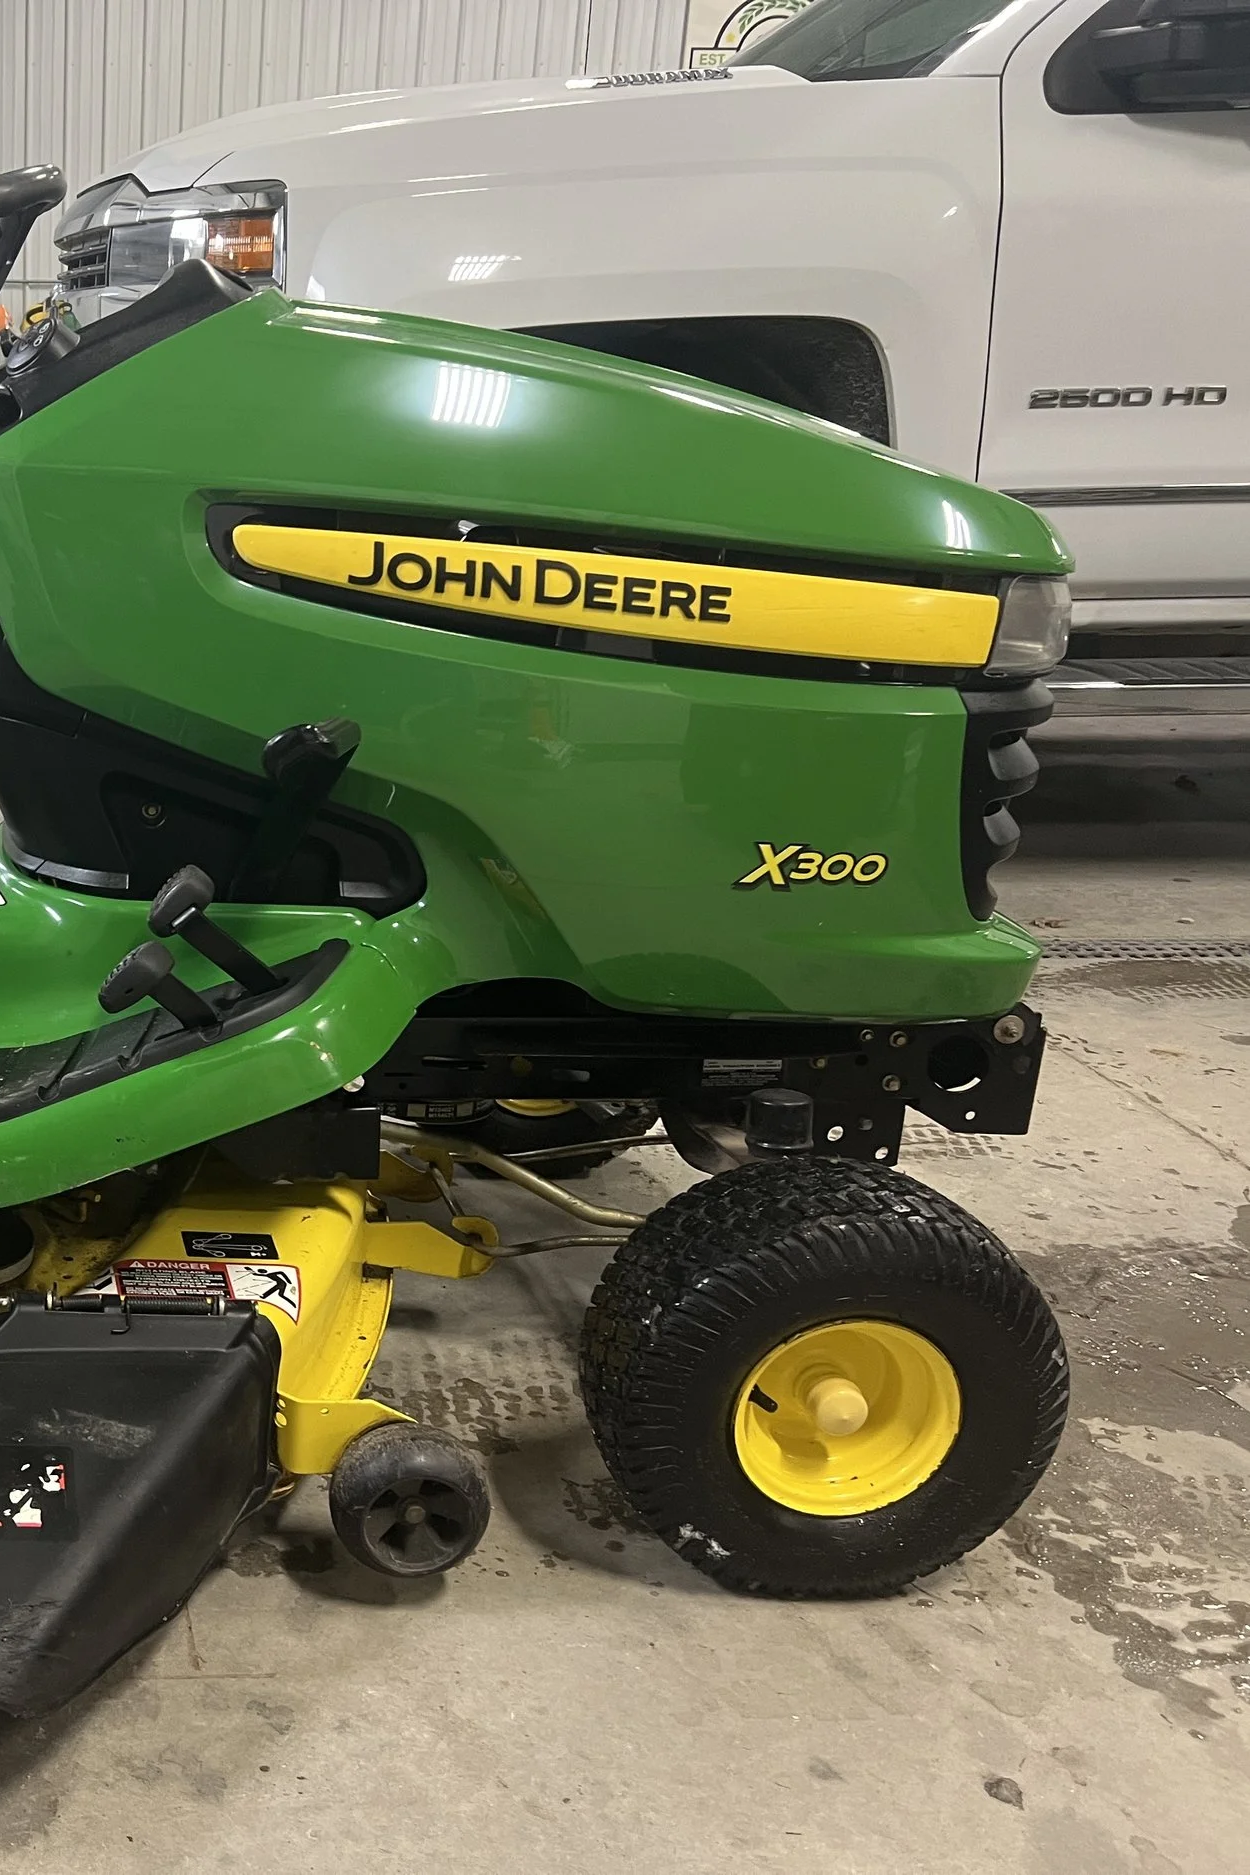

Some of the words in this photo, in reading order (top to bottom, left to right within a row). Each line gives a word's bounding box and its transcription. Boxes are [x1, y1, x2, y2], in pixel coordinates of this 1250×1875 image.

[612, 67, 733, 87] DURAMAX
[1028, 387, 1153, 410] 2500
[1161, 385, 1228, 407] HD
[347, 541, 522, 602] JOHN
[533, 558, 732, 623] DEERE
[733, 842, 888, 890] X300
[147, 1261, 210, 1270] DANGER
